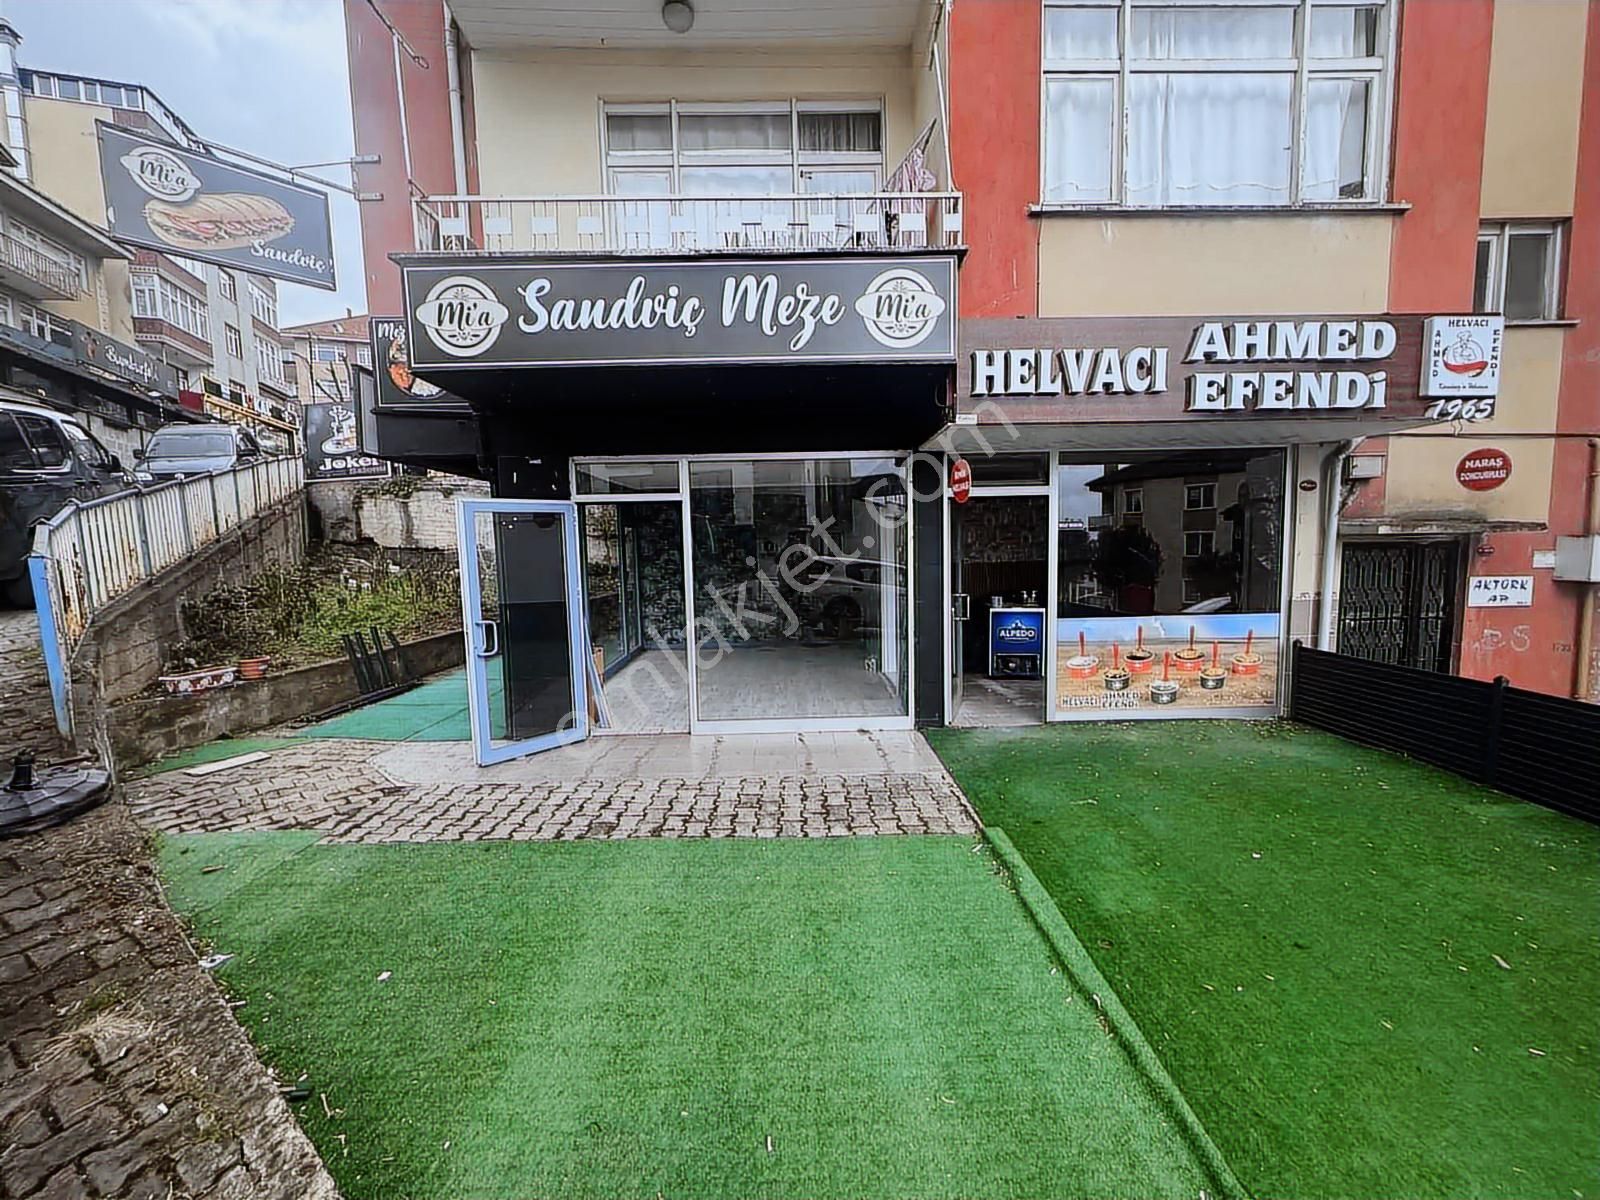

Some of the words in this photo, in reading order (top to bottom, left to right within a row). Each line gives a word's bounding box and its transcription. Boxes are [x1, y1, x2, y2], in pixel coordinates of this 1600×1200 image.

[437, 301, 495, 332] Mi'a
[516, 275, 706, 338] Sandviç
[721, 273, 845, 352] Meze
[875, 294, 932, 323] Mi'a
[1448, 319, 1489, 328] HELVACI
[1182, 319, 1398, 364] AHMED
[970, 346, 1169, 395] HELVACI
[1430, 399, 1495, 420] 1965
